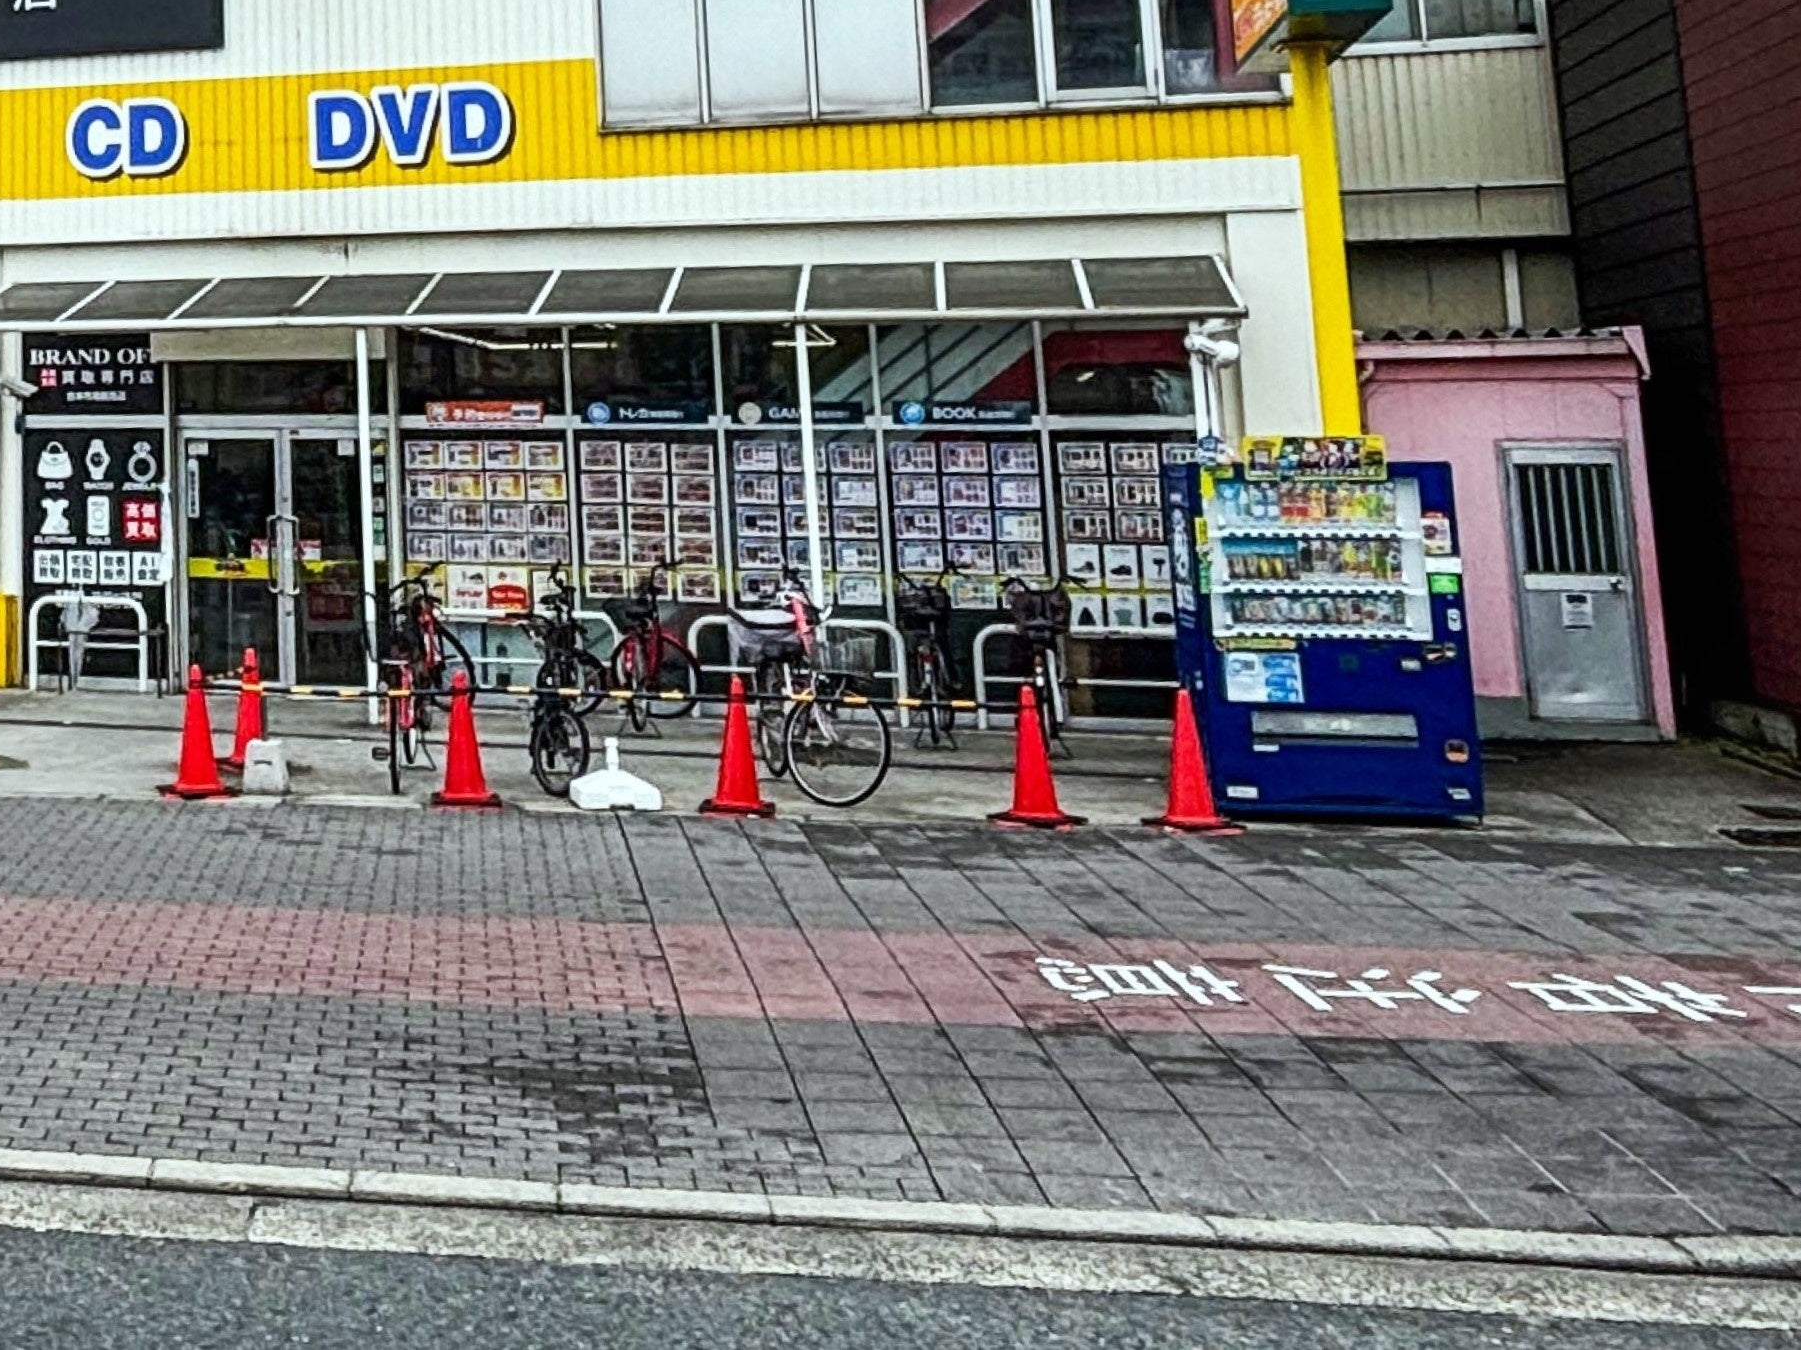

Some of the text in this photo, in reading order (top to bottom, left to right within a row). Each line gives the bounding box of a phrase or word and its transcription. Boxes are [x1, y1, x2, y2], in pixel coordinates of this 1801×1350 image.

[67, 98, 185, 177] CD
[309, 81, 513, 169] DVD
[29, 347, 152, 365] BRAND OF
